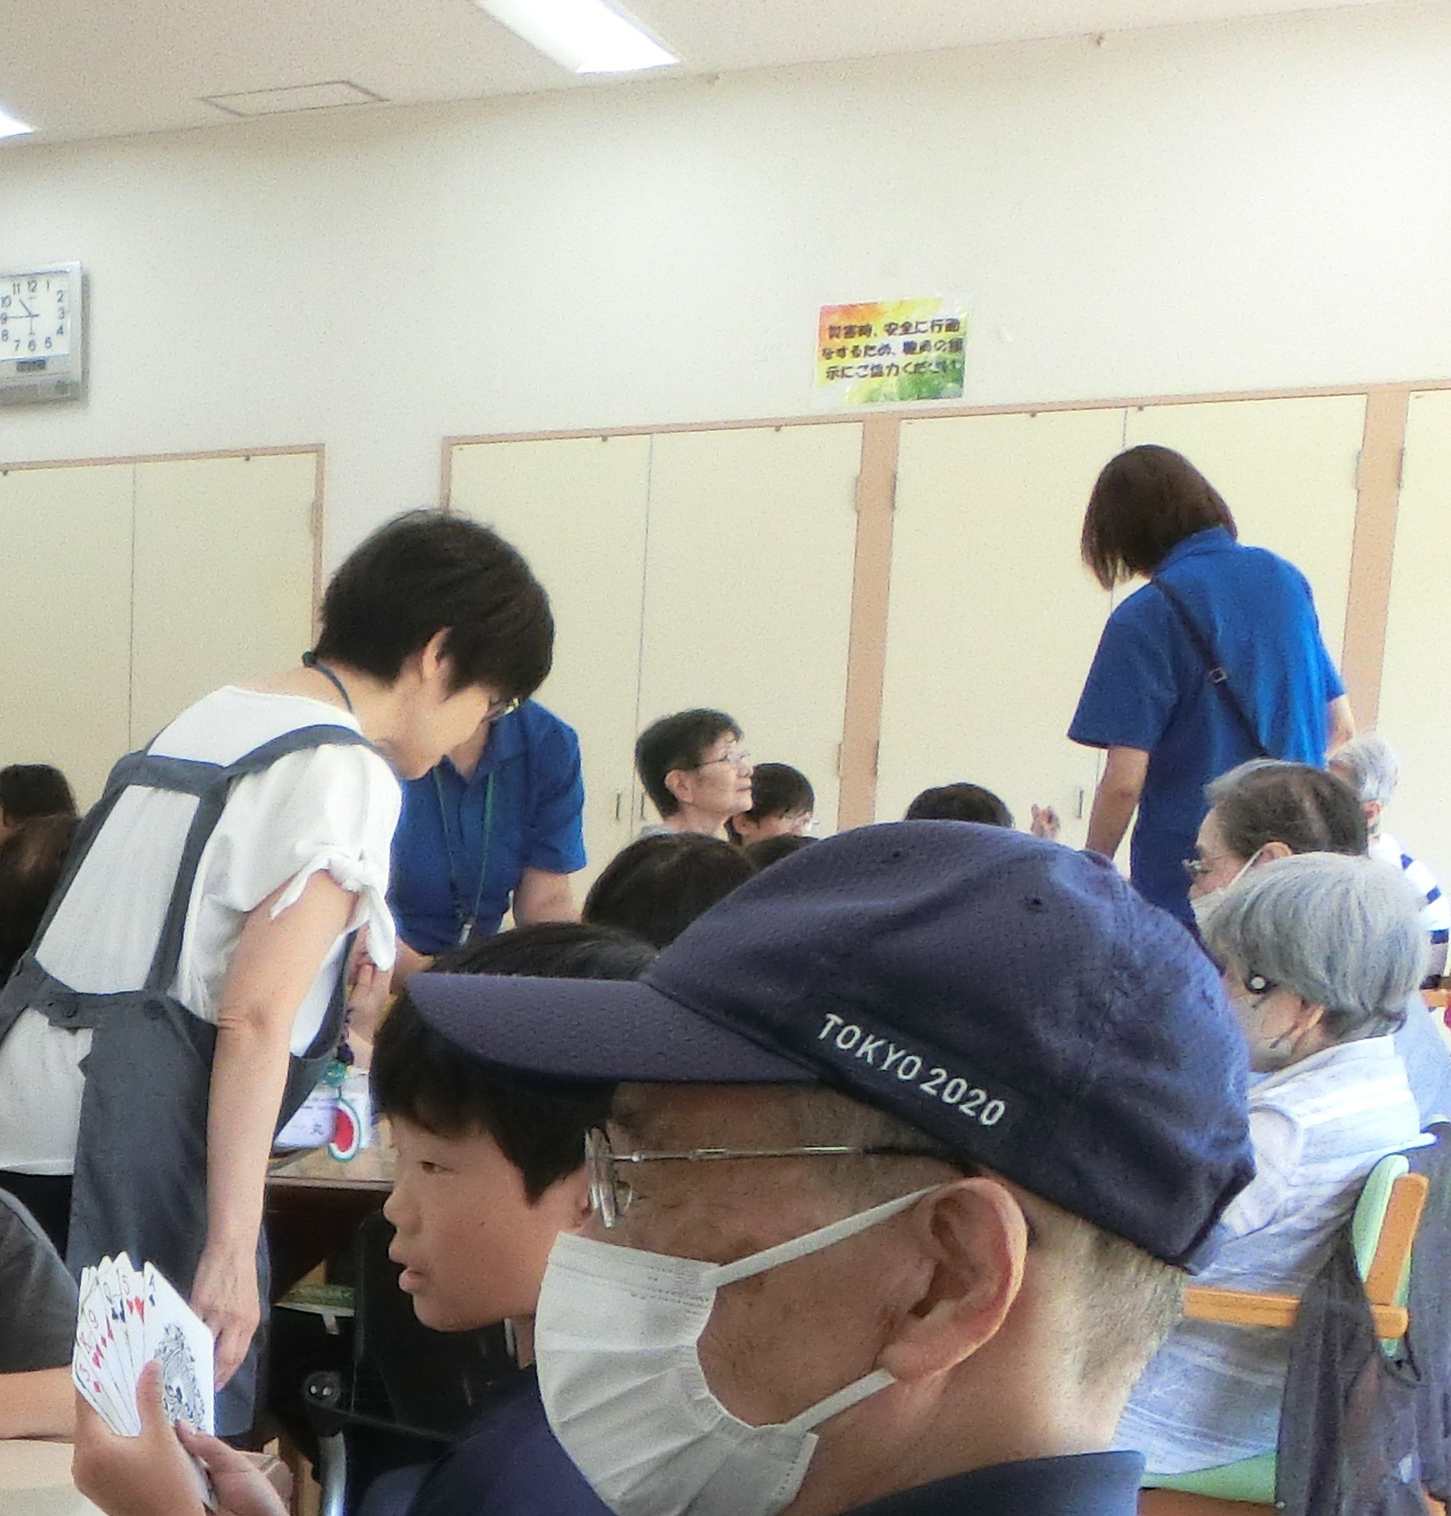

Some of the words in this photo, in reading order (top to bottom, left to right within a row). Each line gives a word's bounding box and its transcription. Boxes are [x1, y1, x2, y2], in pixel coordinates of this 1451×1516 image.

[12, 283, 21, 295] 11
[27, 280, 38, 293] 12
[0, 295, 12, 308] 10
[57, 290, 65, 303] 2
[57, 307, 65, 320] 3
[1, 329, 9, 342] 8
[56, 325, 64, 336] 4
[14, 340, 21, 351] 7
[28, 340, 36, 352] 6
[44, 337, 53, 349] 5
[817, 1013, 923, 1081] TOKYO
[919, 1067, 1006, 1126] 2020
